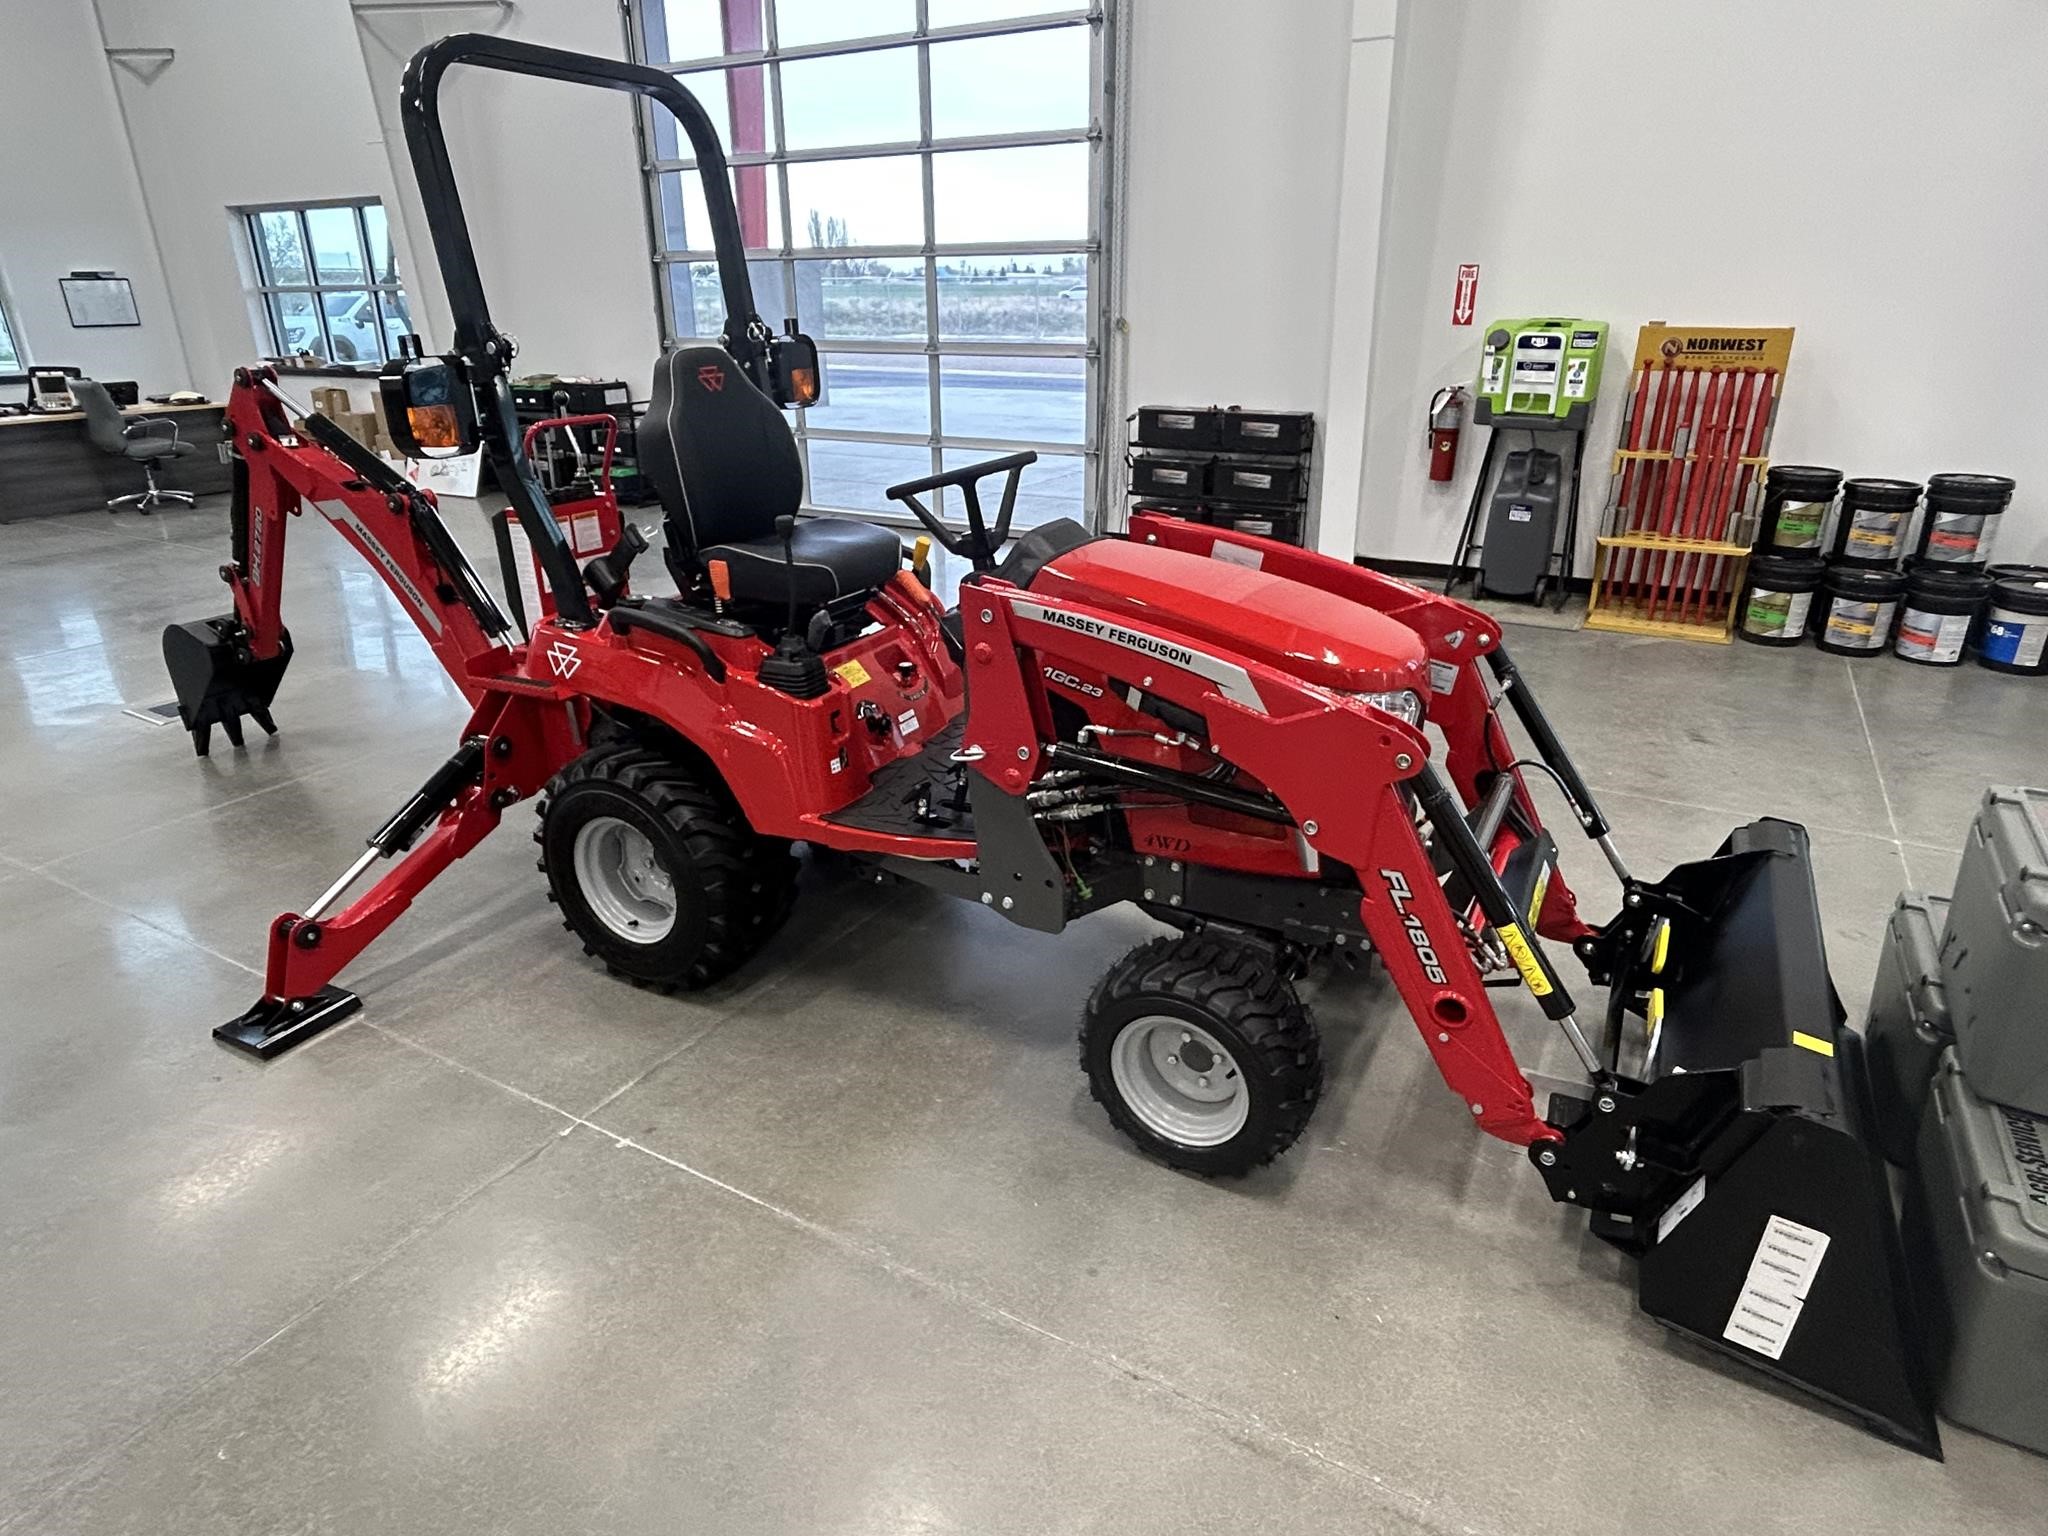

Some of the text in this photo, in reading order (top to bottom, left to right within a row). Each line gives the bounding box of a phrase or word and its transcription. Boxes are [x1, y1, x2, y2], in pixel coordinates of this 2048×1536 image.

[1462, 270, 1476, 279] FIRE
[1686, 338, 1767, 351] NORWEST
[355, 523, 424, 607] MASSEY FERGUSON
[1043, 609, 1192, 665] MASSEY FERGUSON
[1043, 666, 1103, 697] 1GC.23
[1144, 834, 1191, 852] 4WD
[1380, 868, 1448, 984] FL.1805
